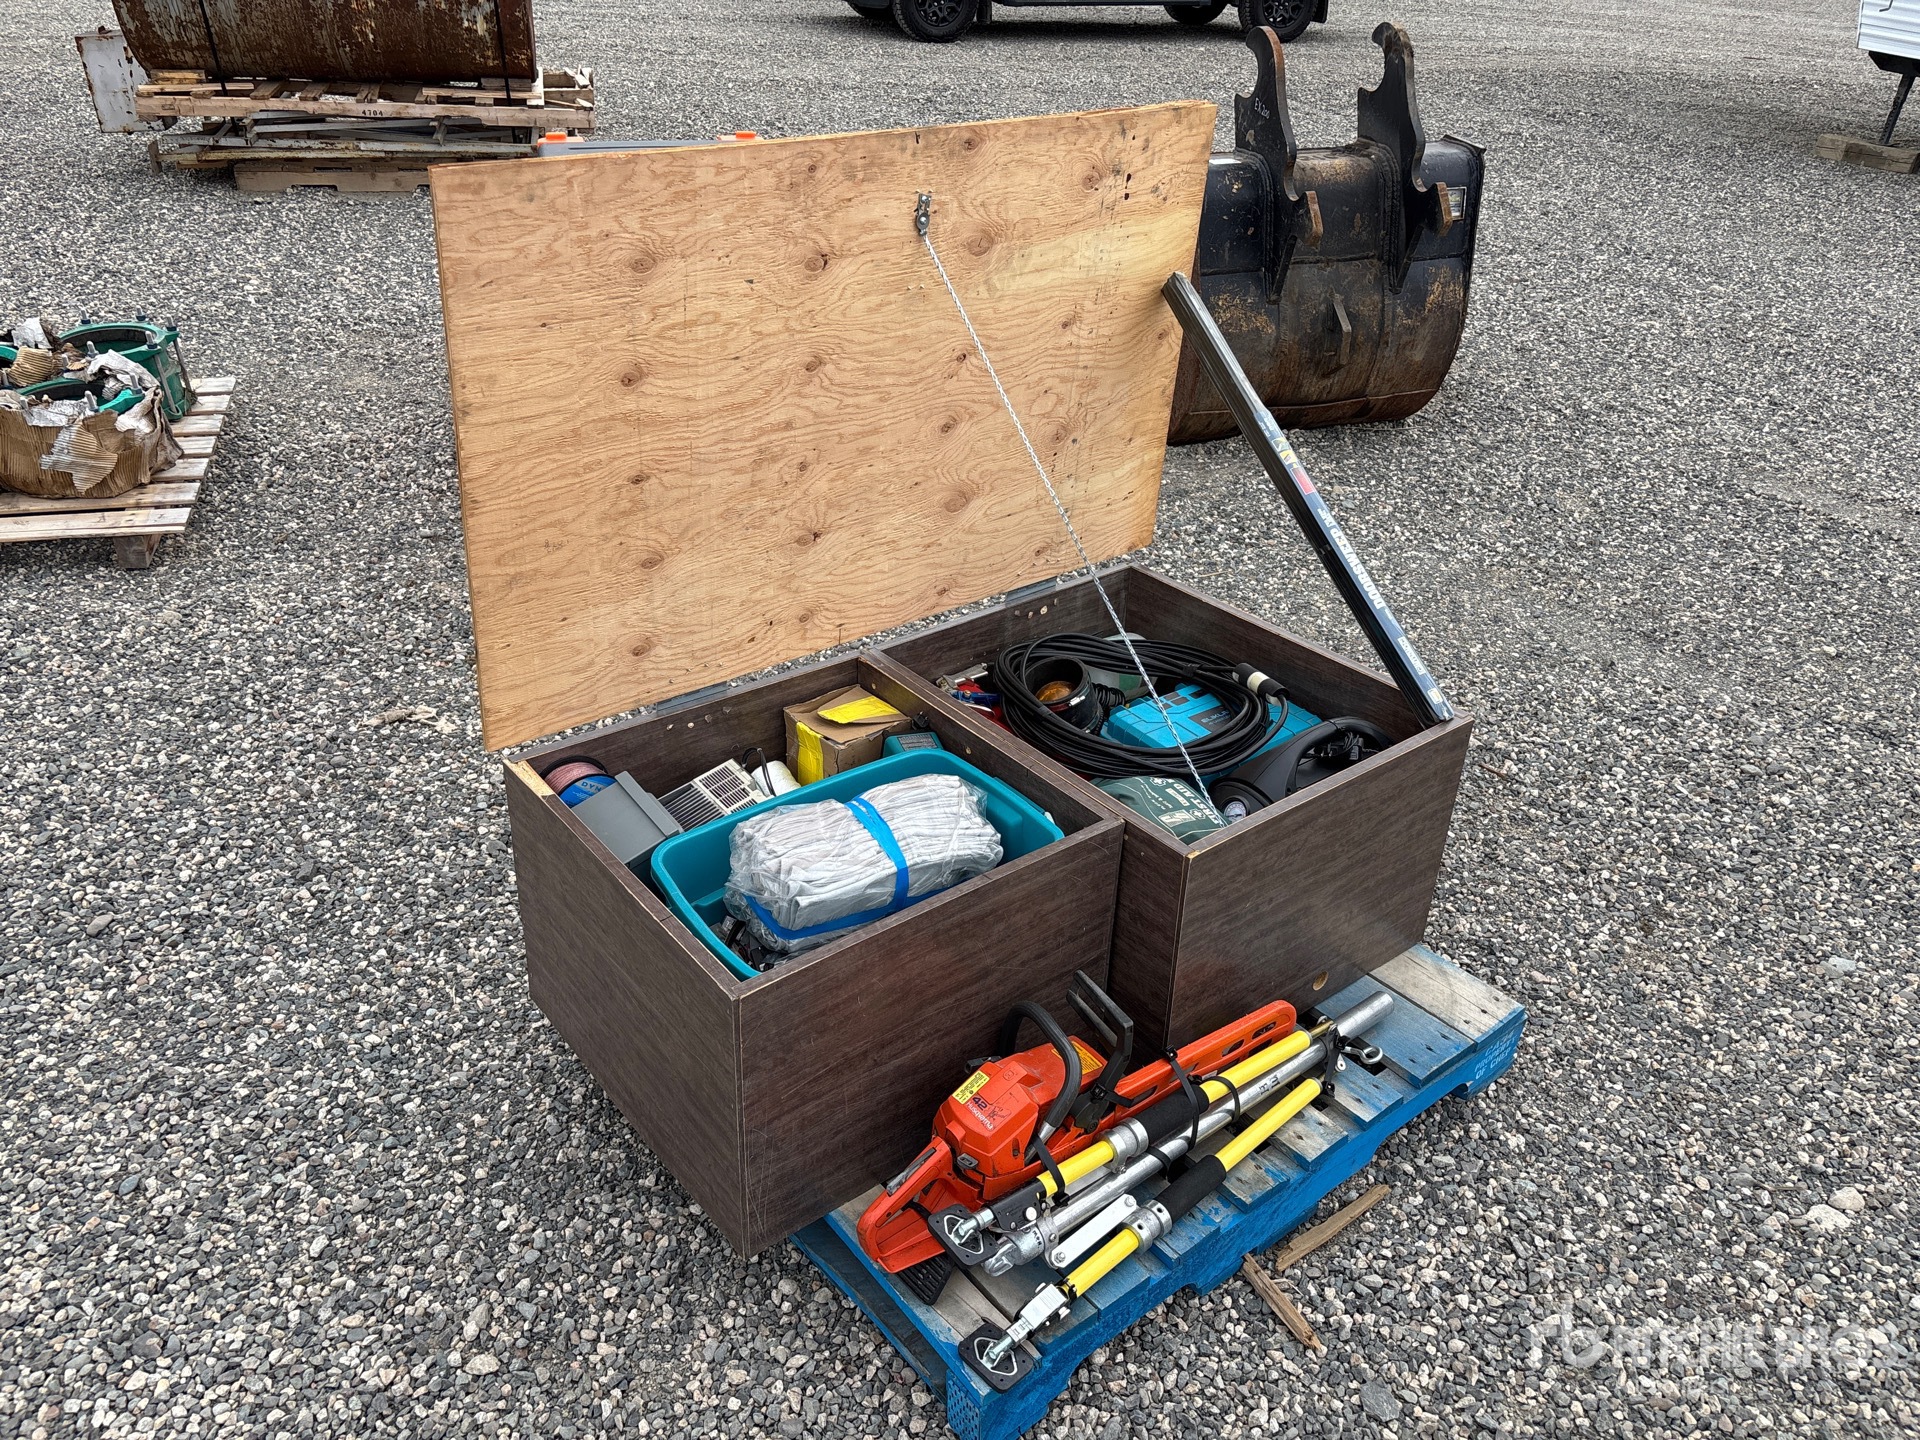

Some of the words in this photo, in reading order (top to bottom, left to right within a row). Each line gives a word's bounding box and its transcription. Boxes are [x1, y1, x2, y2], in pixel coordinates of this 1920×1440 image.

[1330, 528, 1387, 610] DOORSWEEP
[1173, 783, 1195, 798] AID
[1190, 798, 1220, 825] FIRST
[1475, 1064, 1488, 1080] OF
[1490, 1046, 1512, 1069] CHEP
[965, 1101, 994, 1131] Husqvarna
[972, 1096, 988, 1111] 42
